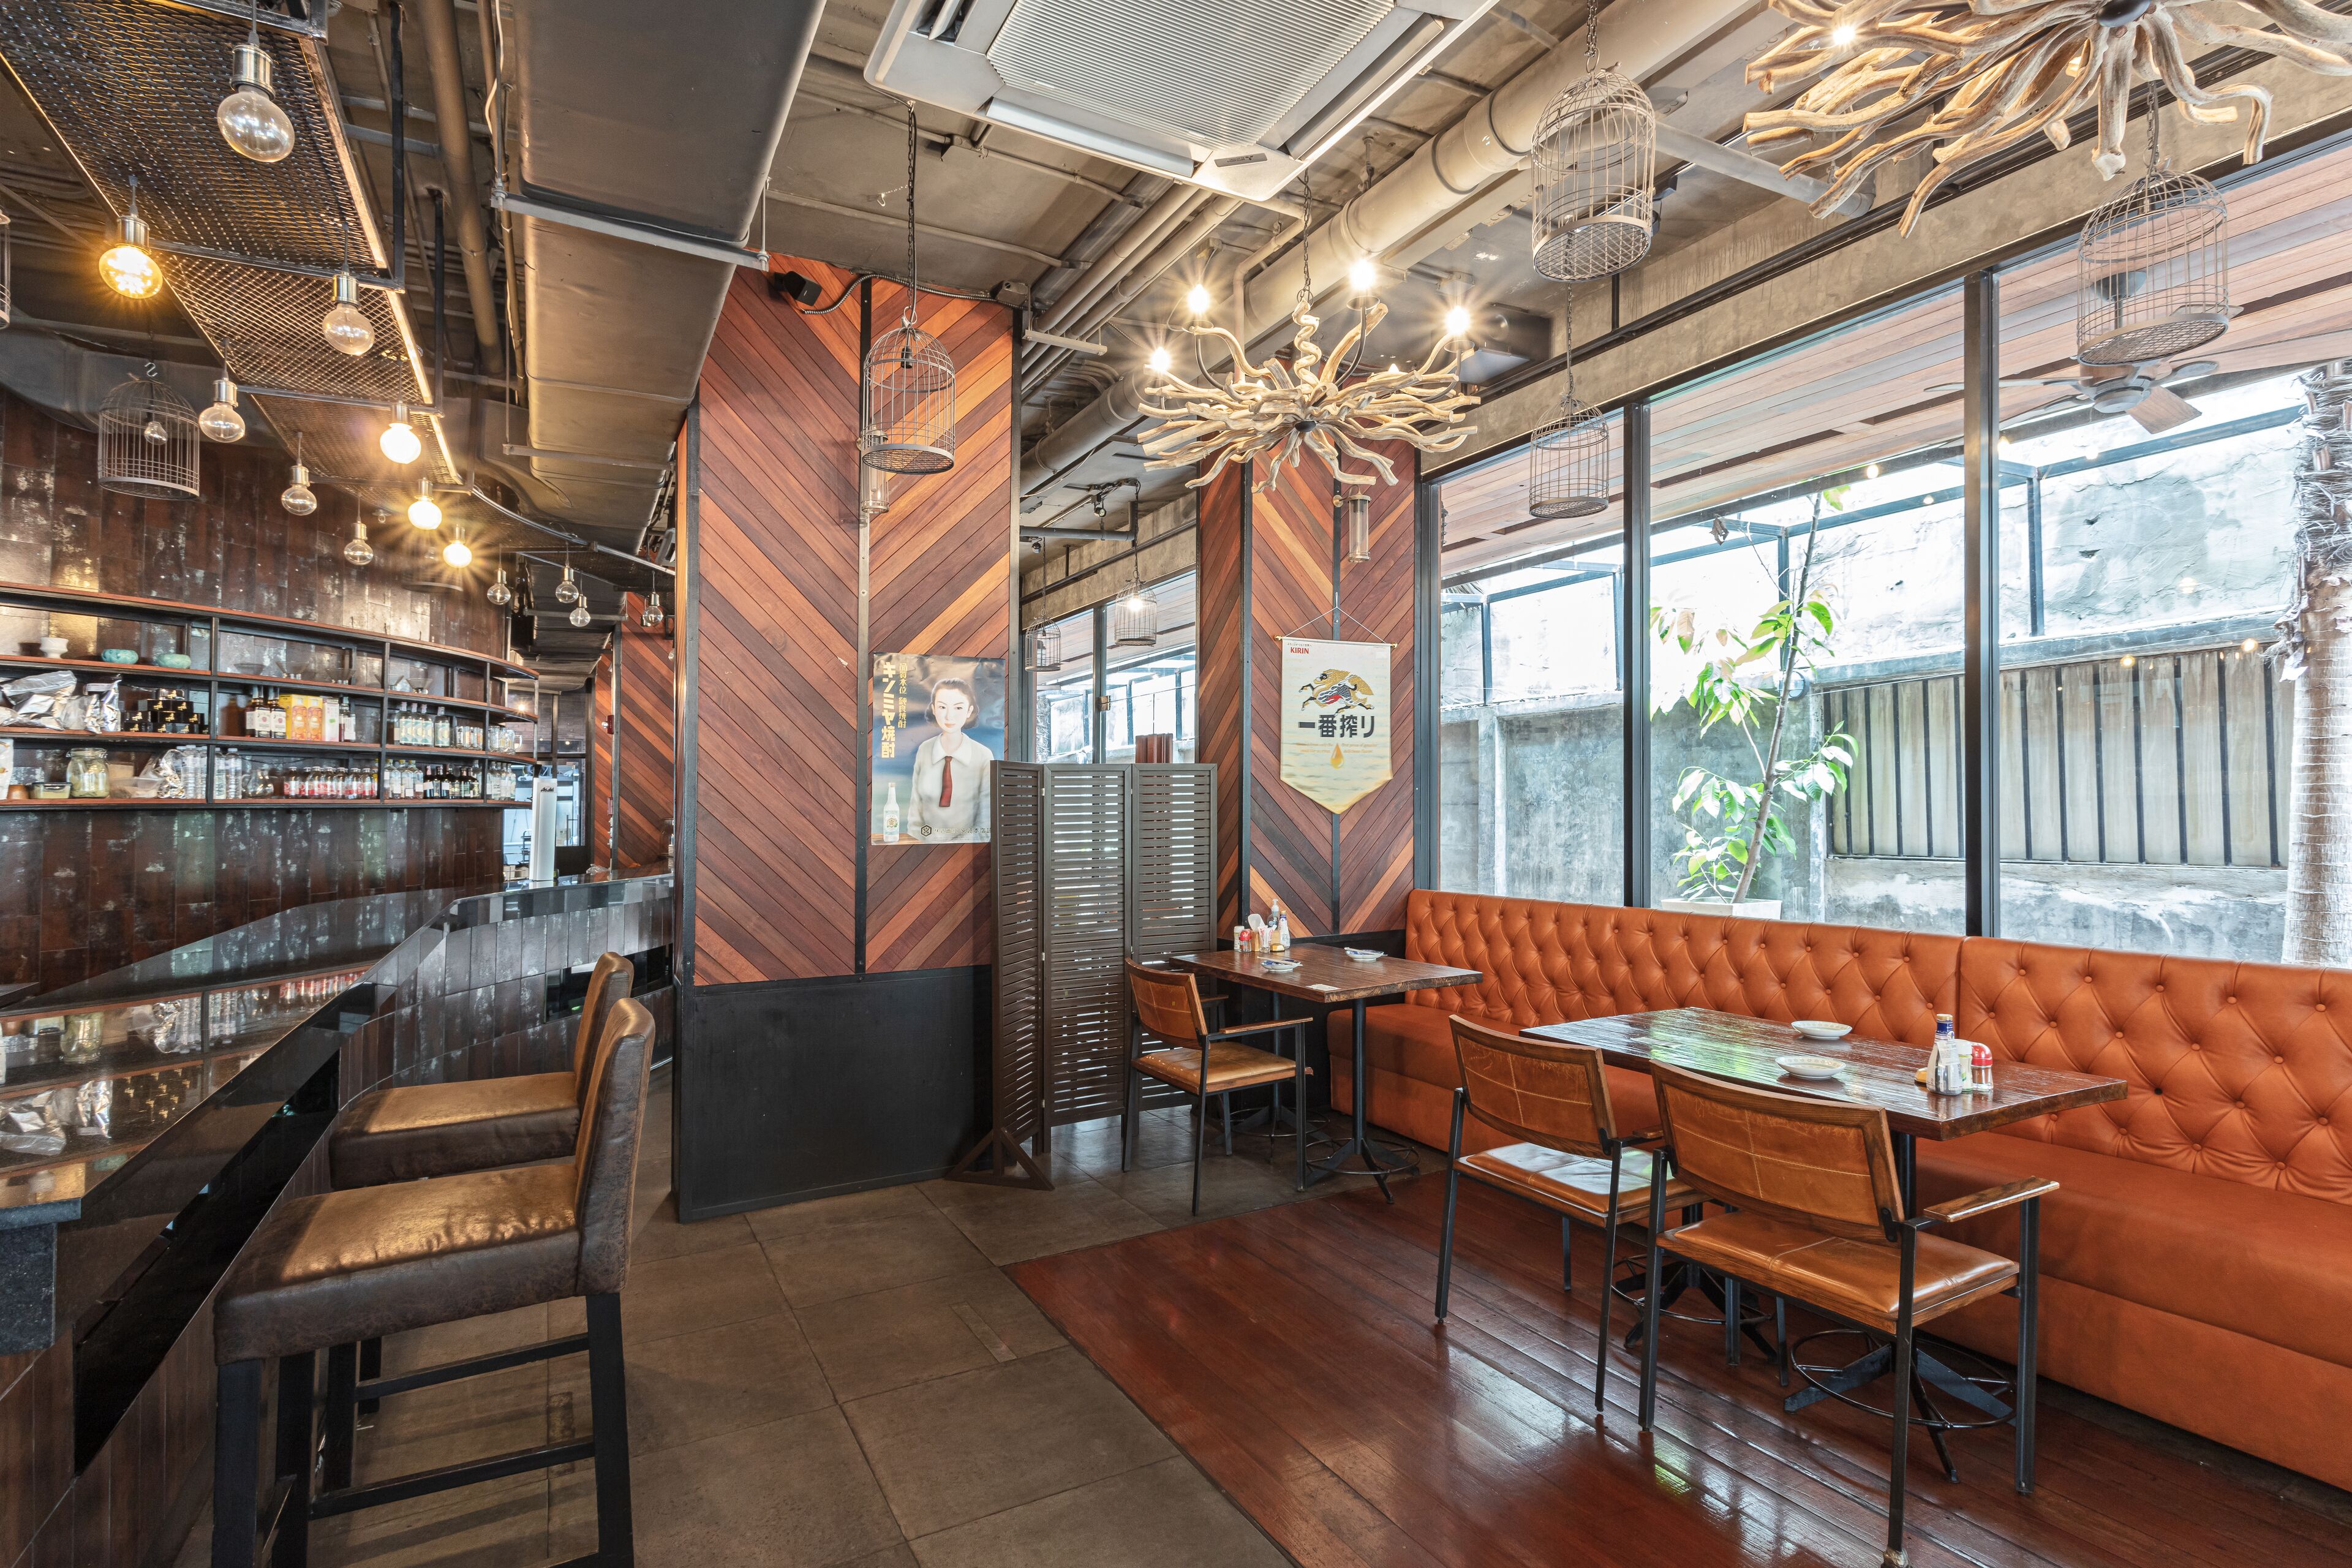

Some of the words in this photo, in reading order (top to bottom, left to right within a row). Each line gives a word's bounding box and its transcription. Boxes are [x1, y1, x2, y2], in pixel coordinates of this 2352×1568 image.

[881, 662, 895, 758] キンミヤ焼酎
[1298, 714, 1374, 738] 一番搾り
